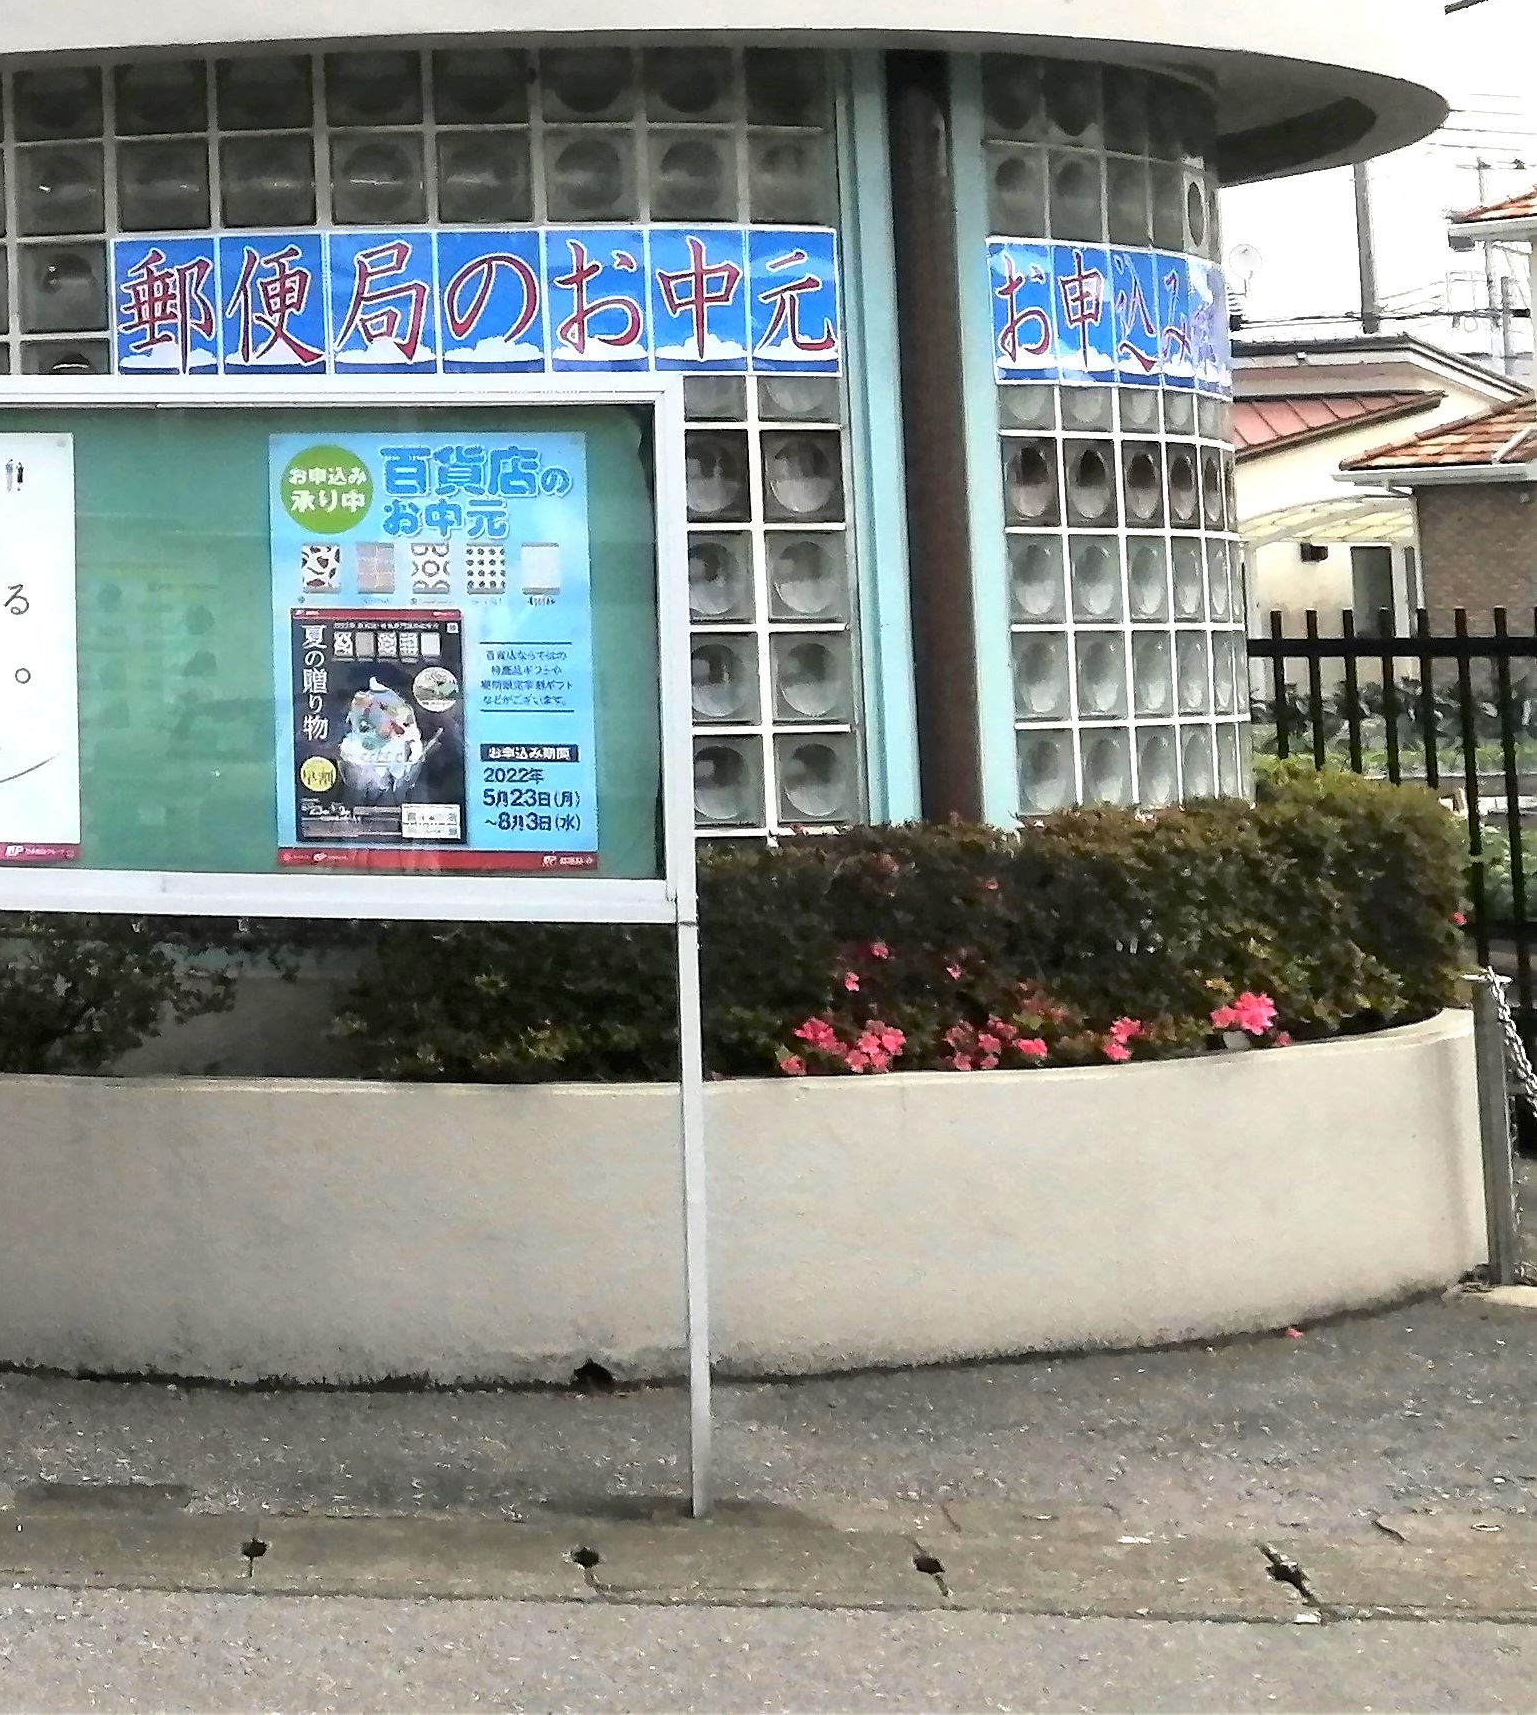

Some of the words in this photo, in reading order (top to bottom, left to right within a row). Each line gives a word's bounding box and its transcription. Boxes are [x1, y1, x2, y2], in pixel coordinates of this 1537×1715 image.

[118, 237, 839, 368] 郵便局のお中元
[287, 466, 368, 487] お申込み
[381, 446, 574, 498] 百貨店の
[291, 489, 366, 514] 承り中
[383, 499, 510, 539] お中元
[302, 624, 328, 740] 夏の贈り物
[483, 767, 545, 785] 2022年
[482, 788, 581, 808] 5月23日(月)
